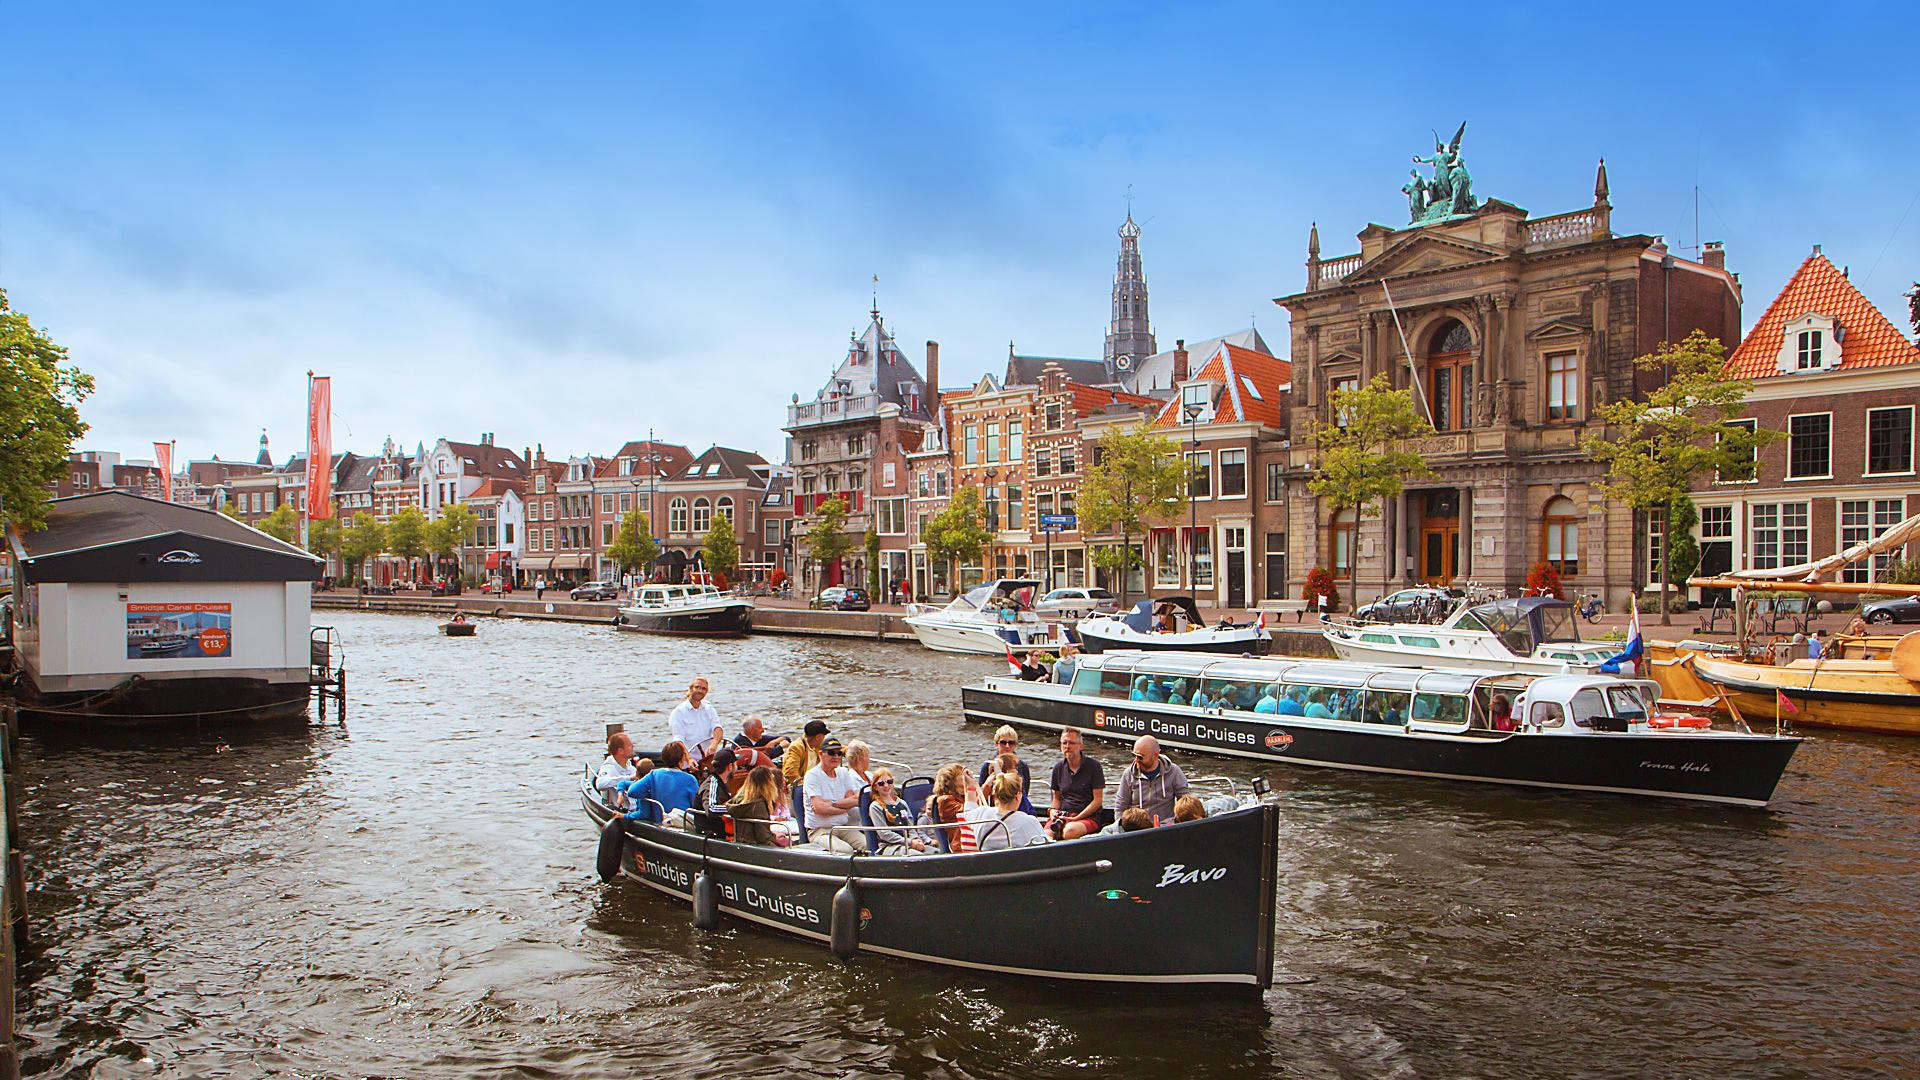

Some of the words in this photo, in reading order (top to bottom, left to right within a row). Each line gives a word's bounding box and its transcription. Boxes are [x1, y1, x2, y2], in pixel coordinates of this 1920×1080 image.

[130, 604, 165, 613] Smidtje
[167, 604, 192, 612] Canal
[194, 604, 229, 612] Cruises
[1095, 711, 1145, 732] Smidtje
[1151, 719, 1189, 736] Canal
[1195, 725, 1256, 745] Cruises
[635, 852, 689, 887] Smidtje
[745, 887, 820, 924] Cruises
[1155, 863, 1227, 888] Bavo
